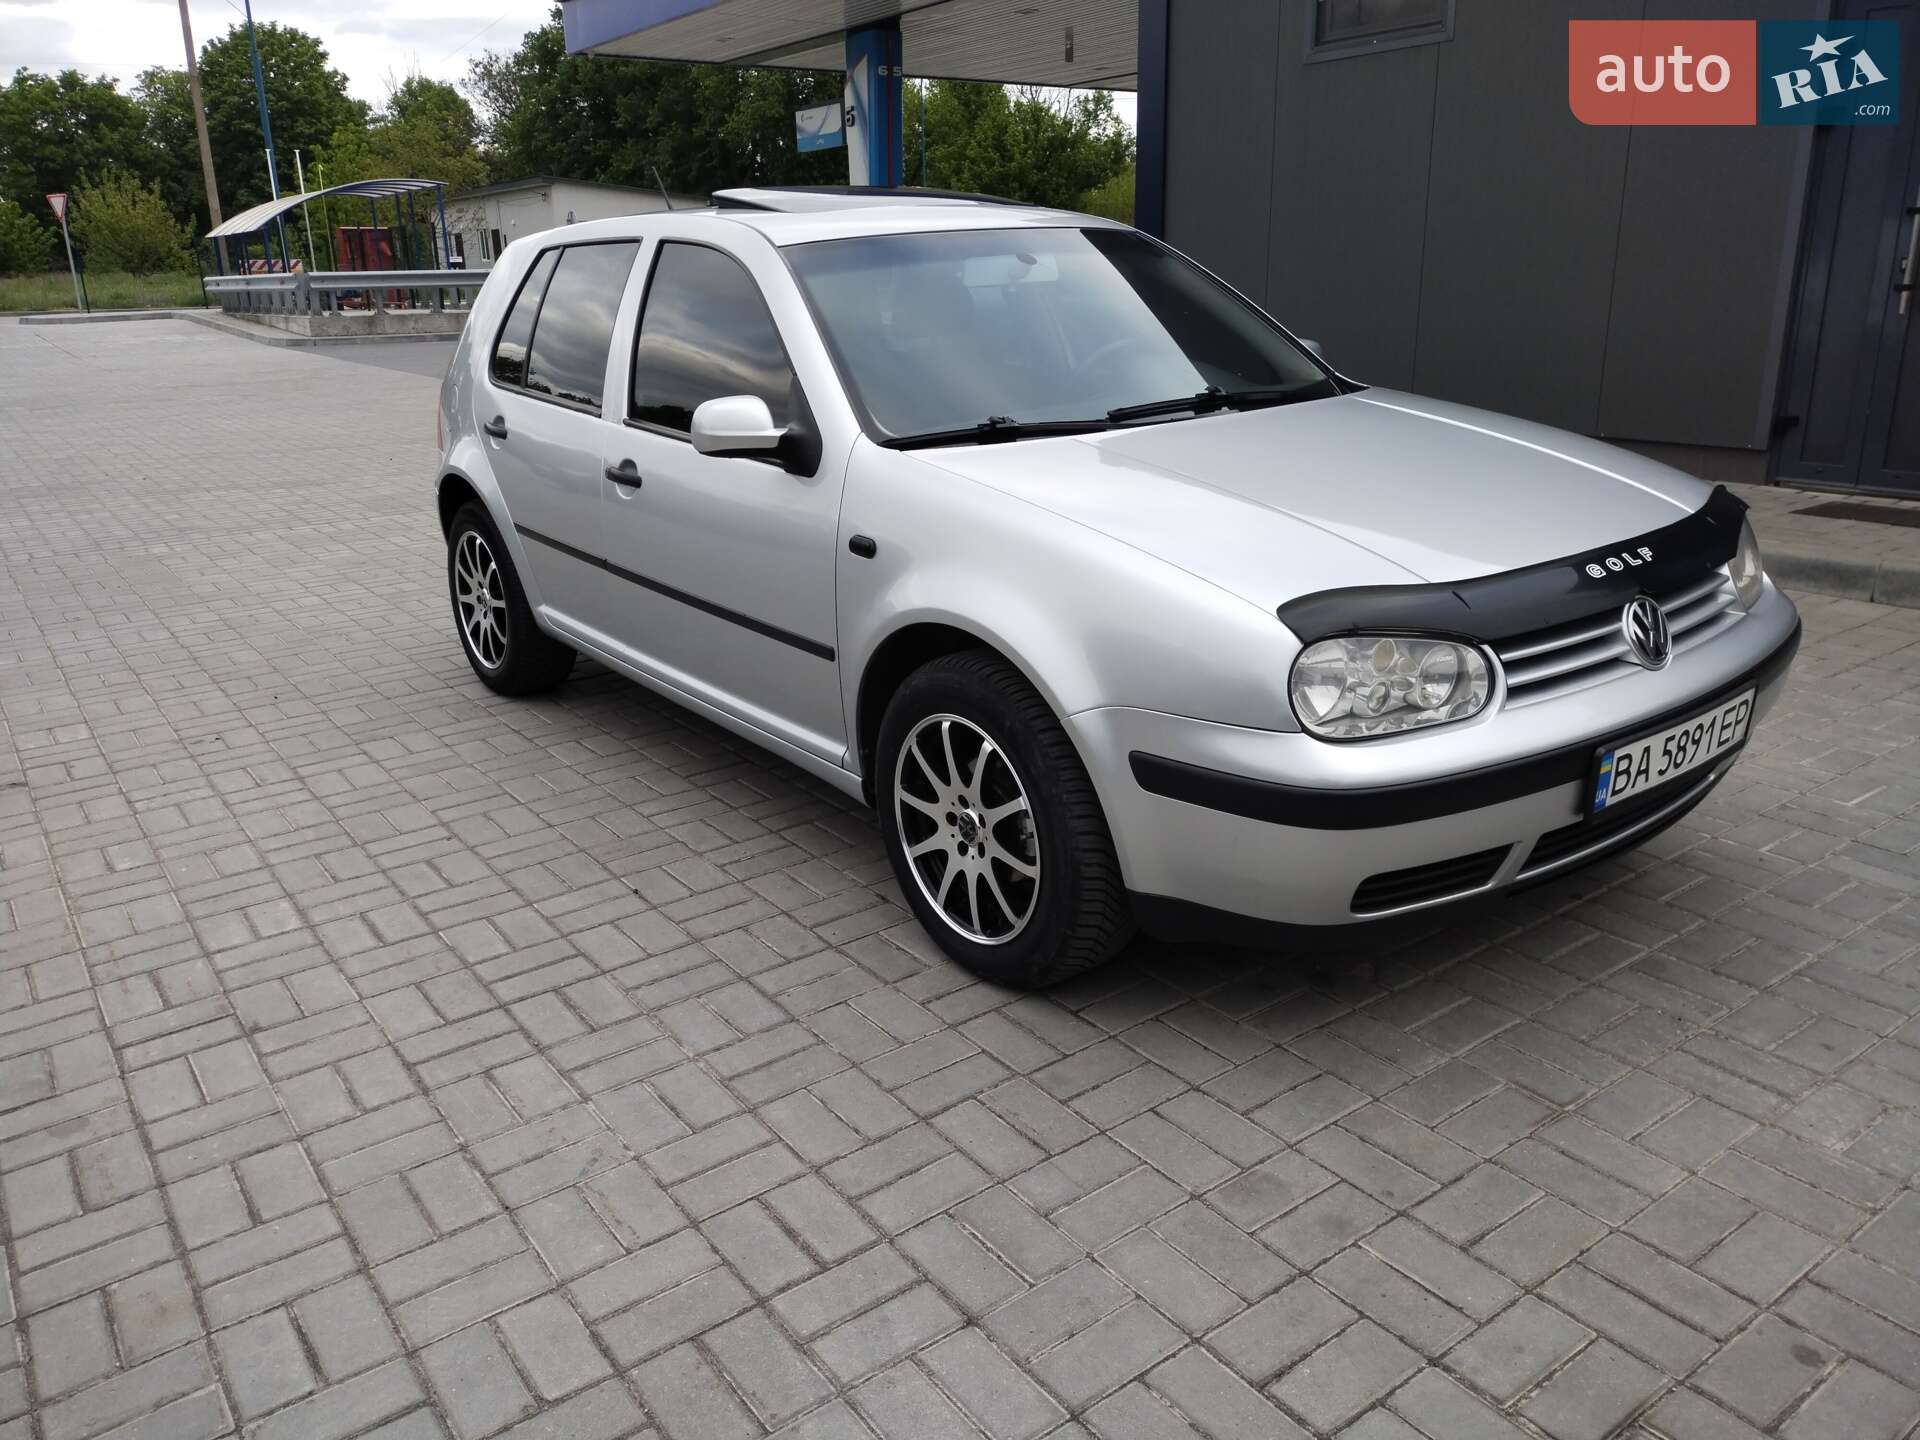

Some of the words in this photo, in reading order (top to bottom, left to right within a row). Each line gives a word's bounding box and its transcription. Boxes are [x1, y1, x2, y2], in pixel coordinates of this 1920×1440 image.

[1585, 547, 1654, 578] GOLF
[1610, 744, 1651, 797] BA
[1657, 715, 1718, 777] 5891
[1717, 698, 1750, 749] EP
[1594, 788, 1608, 803] UA
